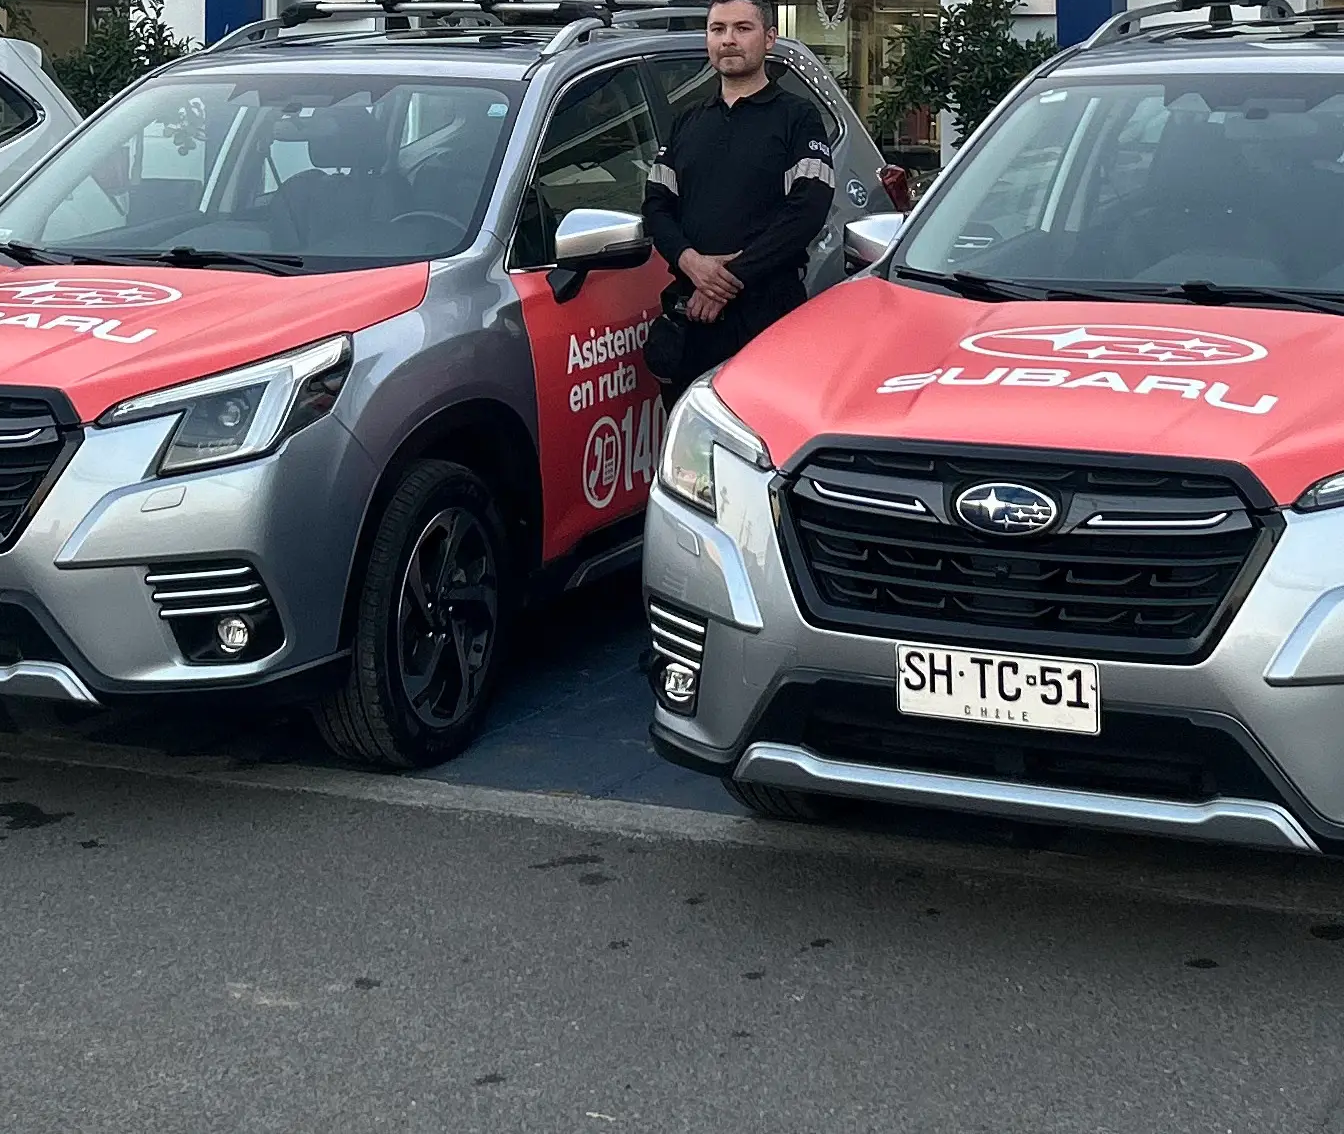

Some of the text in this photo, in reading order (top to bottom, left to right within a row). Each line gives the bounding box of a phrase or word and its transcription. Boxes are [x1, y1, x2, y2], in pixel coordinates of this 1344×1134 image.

[569, 361, 637, 412] en ruta
[875, 366, 1279, 415] SUBARU
[964, 705, 1030, 722] CHILE
